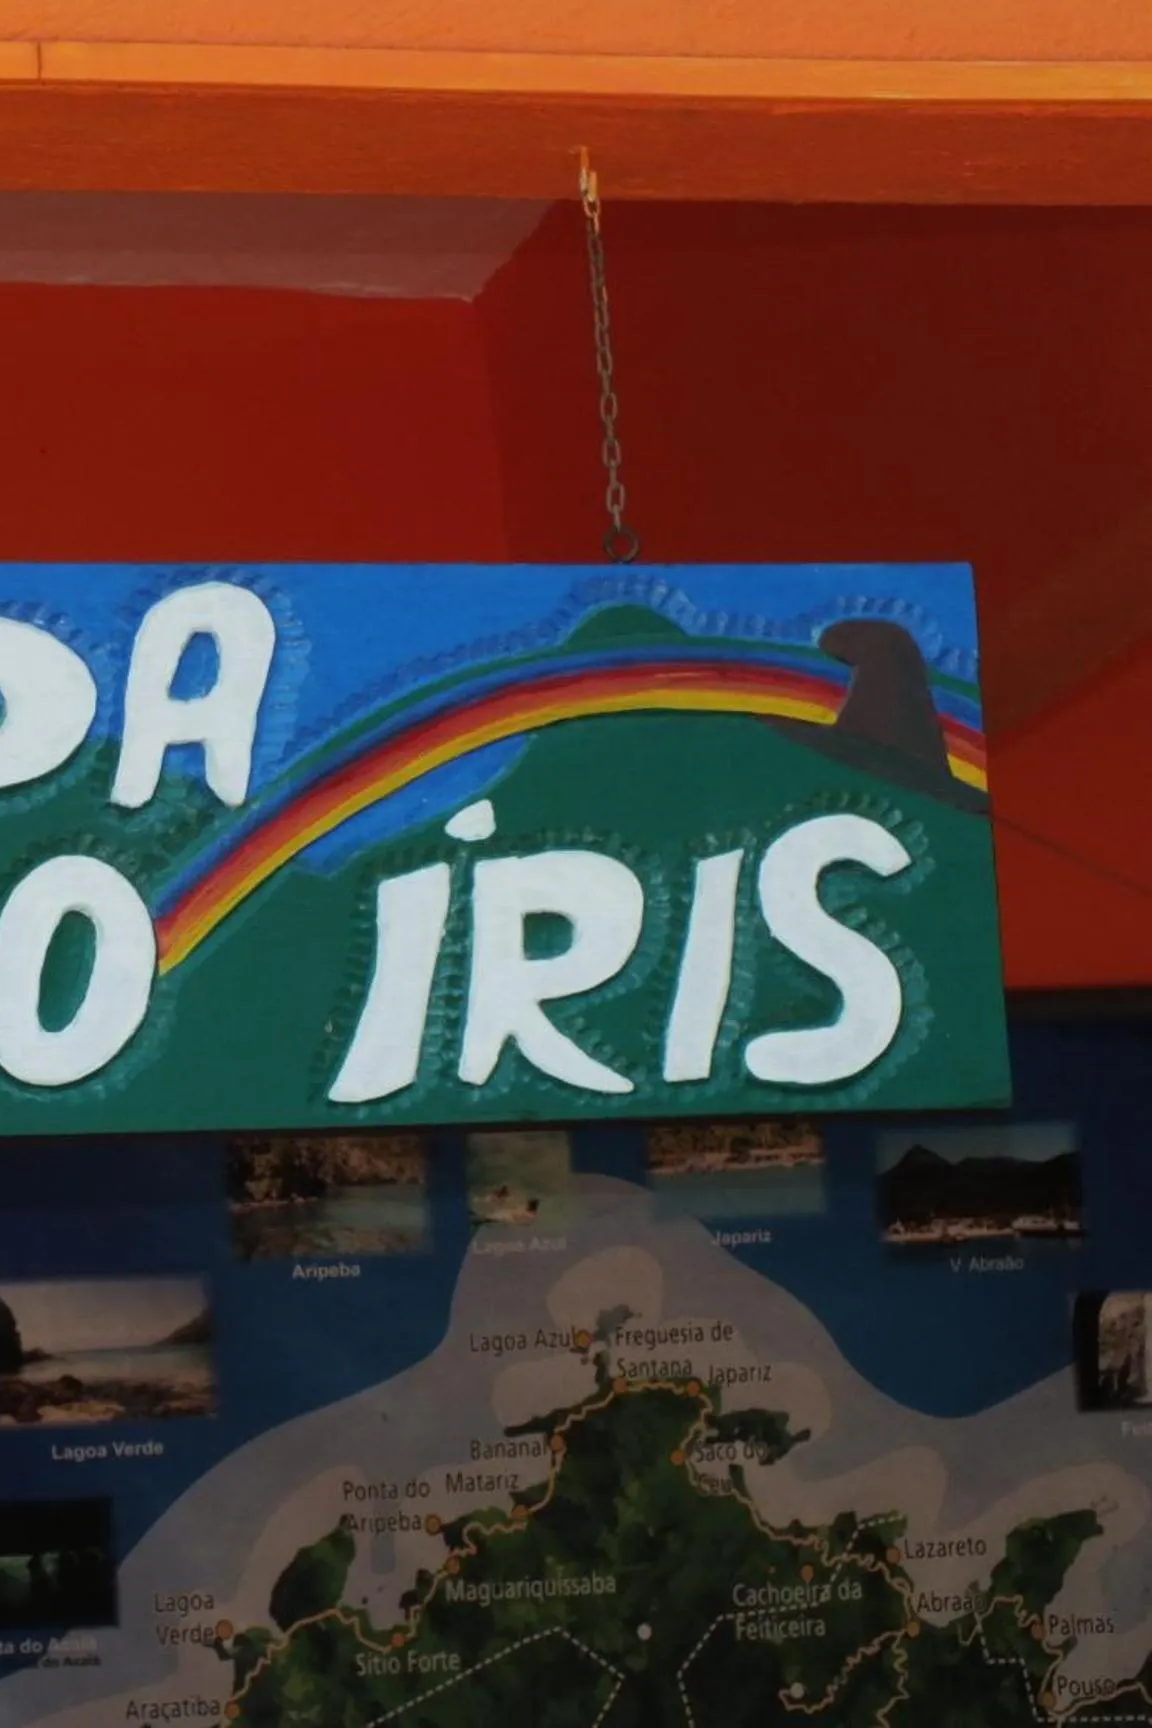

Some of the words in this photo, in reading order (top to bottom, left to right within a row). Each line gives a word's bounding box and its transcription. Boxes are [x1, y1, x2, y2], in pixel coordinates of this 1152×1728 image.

[711, 1229, 772, 1248] Japariz
[292, 1261, 361, 1281] Aripeba
[470, 1332, 528, 1357] Lagoa
[534, 1326, 578, 1348] Azul
[614, 1325, 705, 1352] Freguesia
[711, 1323, 734, 1343] de
[616, 1357, 694, 1378] Santana
[708, 1363, 772, 1387] Japariz
[52, 1443, 108, 1462] Lagoa
[113, 1439, 164, 1457] Verde
[470, 1438, 548, 1460] Bananal
[343, 1480, 399, 1501] Ponta
[405, 1478, 431, 1498] do
[445, 1472, 520, 1494] Matariz
[346, 1514, 422, 1535] Aripeba
[904, 1537, 987, 1560] Lazareto
[154, 1593, 215, 1617] Lagoa
[732, 1581, 832, 1608] Cachoeira
[837, 1580, 863, 1600] da
[157, 1623, 215, 1646] Verde
[735, 1615, 826, 1640] Feiticeira
[1049, 1612, 1115, 1636] Palmas
[19, 1637, 44, 1654] do
[408, 1650, 462, 1673] Forte
[1056, 1675, 1117, 1698] Pouso
[125, 1697, 222, 1724] Araçatiba
